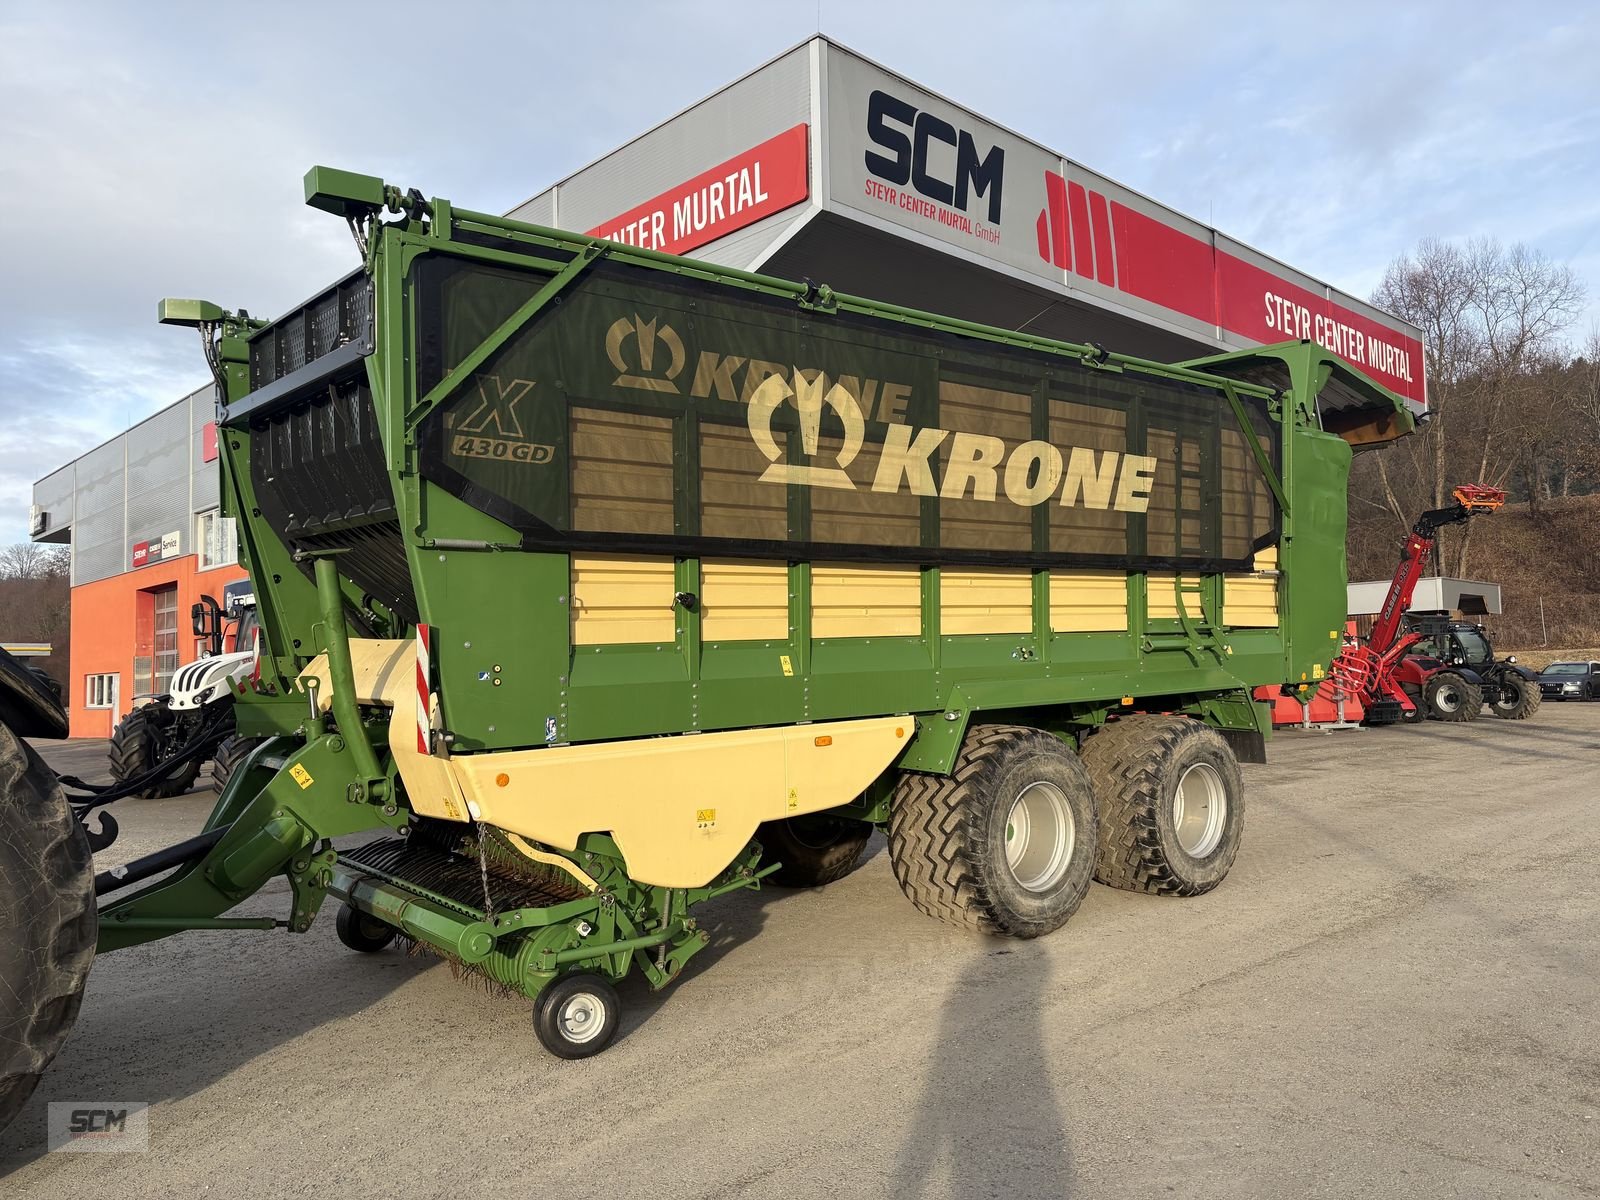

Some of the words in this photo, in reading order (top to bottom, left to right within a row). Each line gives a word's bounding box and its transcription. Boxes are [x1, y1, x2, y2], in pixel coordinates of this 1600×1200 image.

[864, 90, 1005, 225] SCM
[673, 161, 768, 241] MURTAL
[865, 179, 897, 205] STEYR
[899, 193, 936, 220] CENTER
[938, 207, 973, 235] MURTAL
[974, 222, 1001, 246] GmbH
[1264, 291, 1311, 340] STEYR
[1315, 313, 1366, 365] CENTER
[1367, 335, 1413, 383] MURTAL
[690, 350, 913, 425] KRONE
[871, 423, 1157, 513] KRONE
[162, 538, 177, 550] Service
